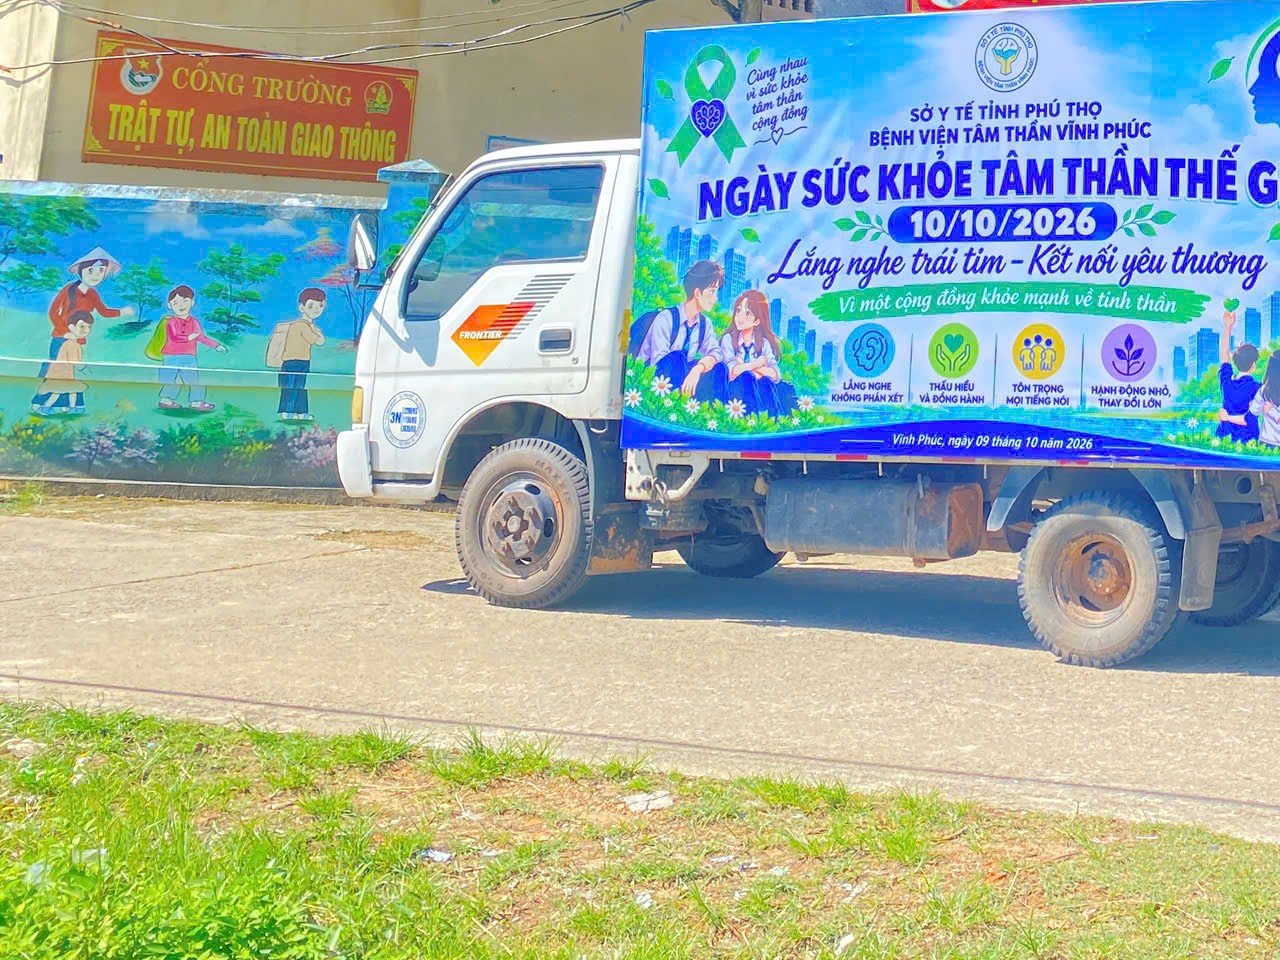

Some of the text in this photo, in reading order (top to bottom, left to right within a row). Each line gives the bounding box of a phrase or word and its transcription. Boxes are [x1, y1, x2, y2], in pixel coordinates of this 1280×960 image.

[172, 57, 352, 106] CỔNG TRƯỜNG
[747, 57, 808, 85] Cùng nhau
[746, 72, 808, 101] vì sức khỏe
[752, 89, 803, 115] tâm thần
[910, 98, 1102, 122] SỞ Y TẾ TỈNH PHÚ THỌ
[752, 105, 808, 131] cộng đồng
[108, 99, 397, 163] TRẬT TỰ, AN TOÀN GIAO THÔNG
[870, 118, 1152, 150] BỆNH VIỆN TÂM THẦN VĨNH PHÚC
[698, 164, 797, 221] NGÀY
[801, 157, 870, 208] SỨC
[878, 150, 973, 201] KHỎE
[981, 150, 1054, 196] TÂM
[1062, 143, 1158, 196] THẦN
[1165, 144, 1240, 201] THẾ
[910, 207, 1096, 238] 10/10/2026
[767, 238, 844, 290] Lắng
[846, 245, 905, 289] nghe
[911, 247, 958, 275] trái
[958, 247, 1006, 274] tim
[1028, 243, 1073, 275] Kết
[1075, 243, 1118, 274] nối
[1119, 247, 1167, 287] yêu
[1171, 243, 1268, 290] thương
[839, 288, 1177, 315] Vì một cộng đồng khỏe mạnh về tinh thần
[458, 330, 503, 340] FRONTIER
[831, 392, 904, 403] KHÔNG PHÁN XÉT
[868, 382, 892, 391] NGHE
[929, 380, 952, 391] THẤU
[1012, 382, 1064, 396] TÔN TRỌNG
[1091, 384, 1171, 398] HẠNH ĐỘNG NHỎ,
[919, 393, 931, 403] VÀ
[960, 394, 984, 404] HÀNH
[1006, 394, 1069, 407] MỌI TIẾNG NÓI
[1098, 398, 1122, 408] THAY
[1143, 397, 1161, 408] LỚN
[893, 433, 1093, 449] Vĩnh Phúc, ngày 09 tháng 10 năm 2026
